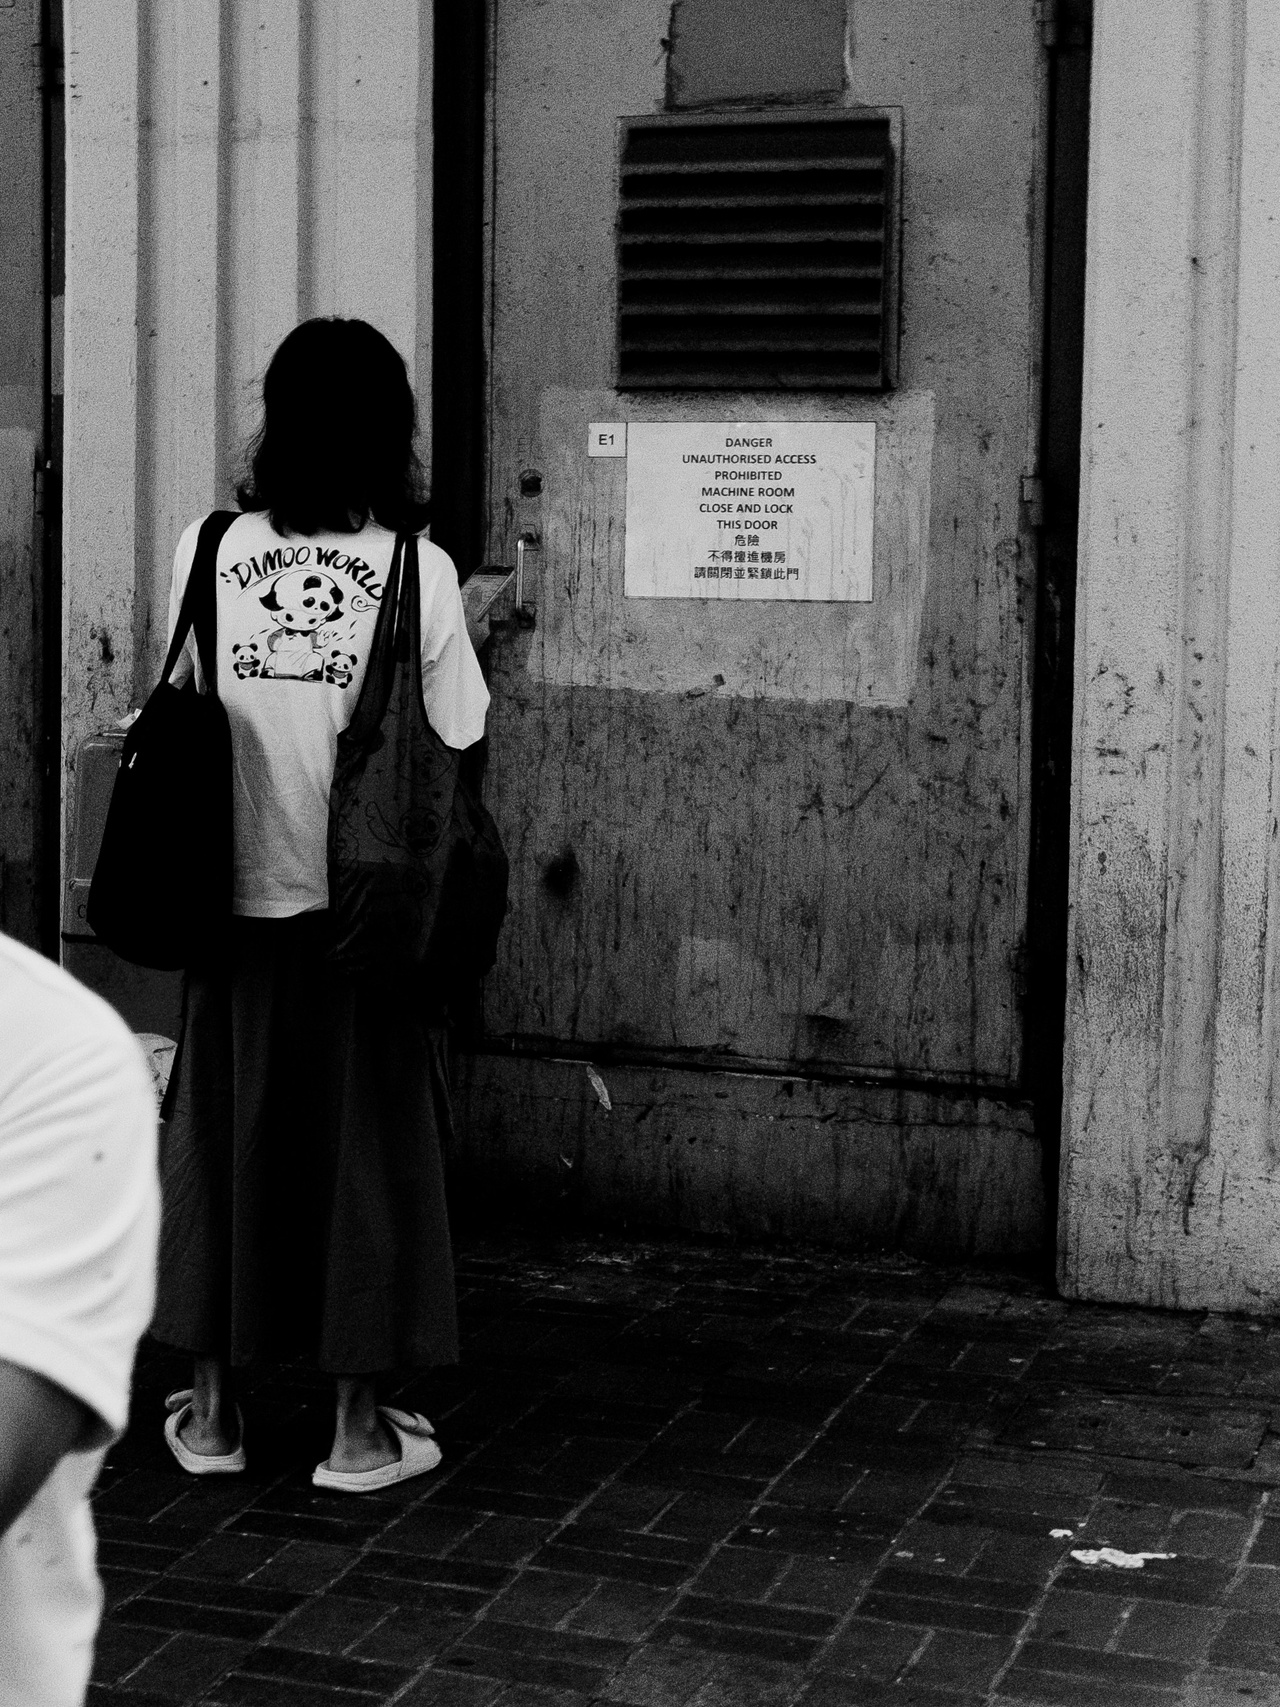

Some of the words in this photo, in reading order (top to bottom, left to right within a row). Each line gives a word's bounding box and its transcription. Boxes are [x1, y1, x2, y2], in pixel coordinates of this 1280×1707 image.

[598, 433, 614, 446] E1
[725, 437, 773, 448] DANGER
[682, 454, 772, 464] UNAUTHORISED
[774, 454, 817, 464] ACCESS
[714, 470, 783, 481] PROHIBITED
[701, 487, 754, 497] MACHINE
[758, 487, 795, 498] ROOM
[699, 503, 733, 513] CLOSE
[736, 503, 762, 514] AND
[764, 503, 793, 514] LOCK
[717, 519, 742, 530] THIS
[744, 520, 778, 530] DOOR
[734, 534, 760, 547] 危險
[230, 546, 311, 590] DIMOO
[315, 547, 384, 600] WORLD
[694, 566, 799, 581] 請關閉並緊鎖此門
